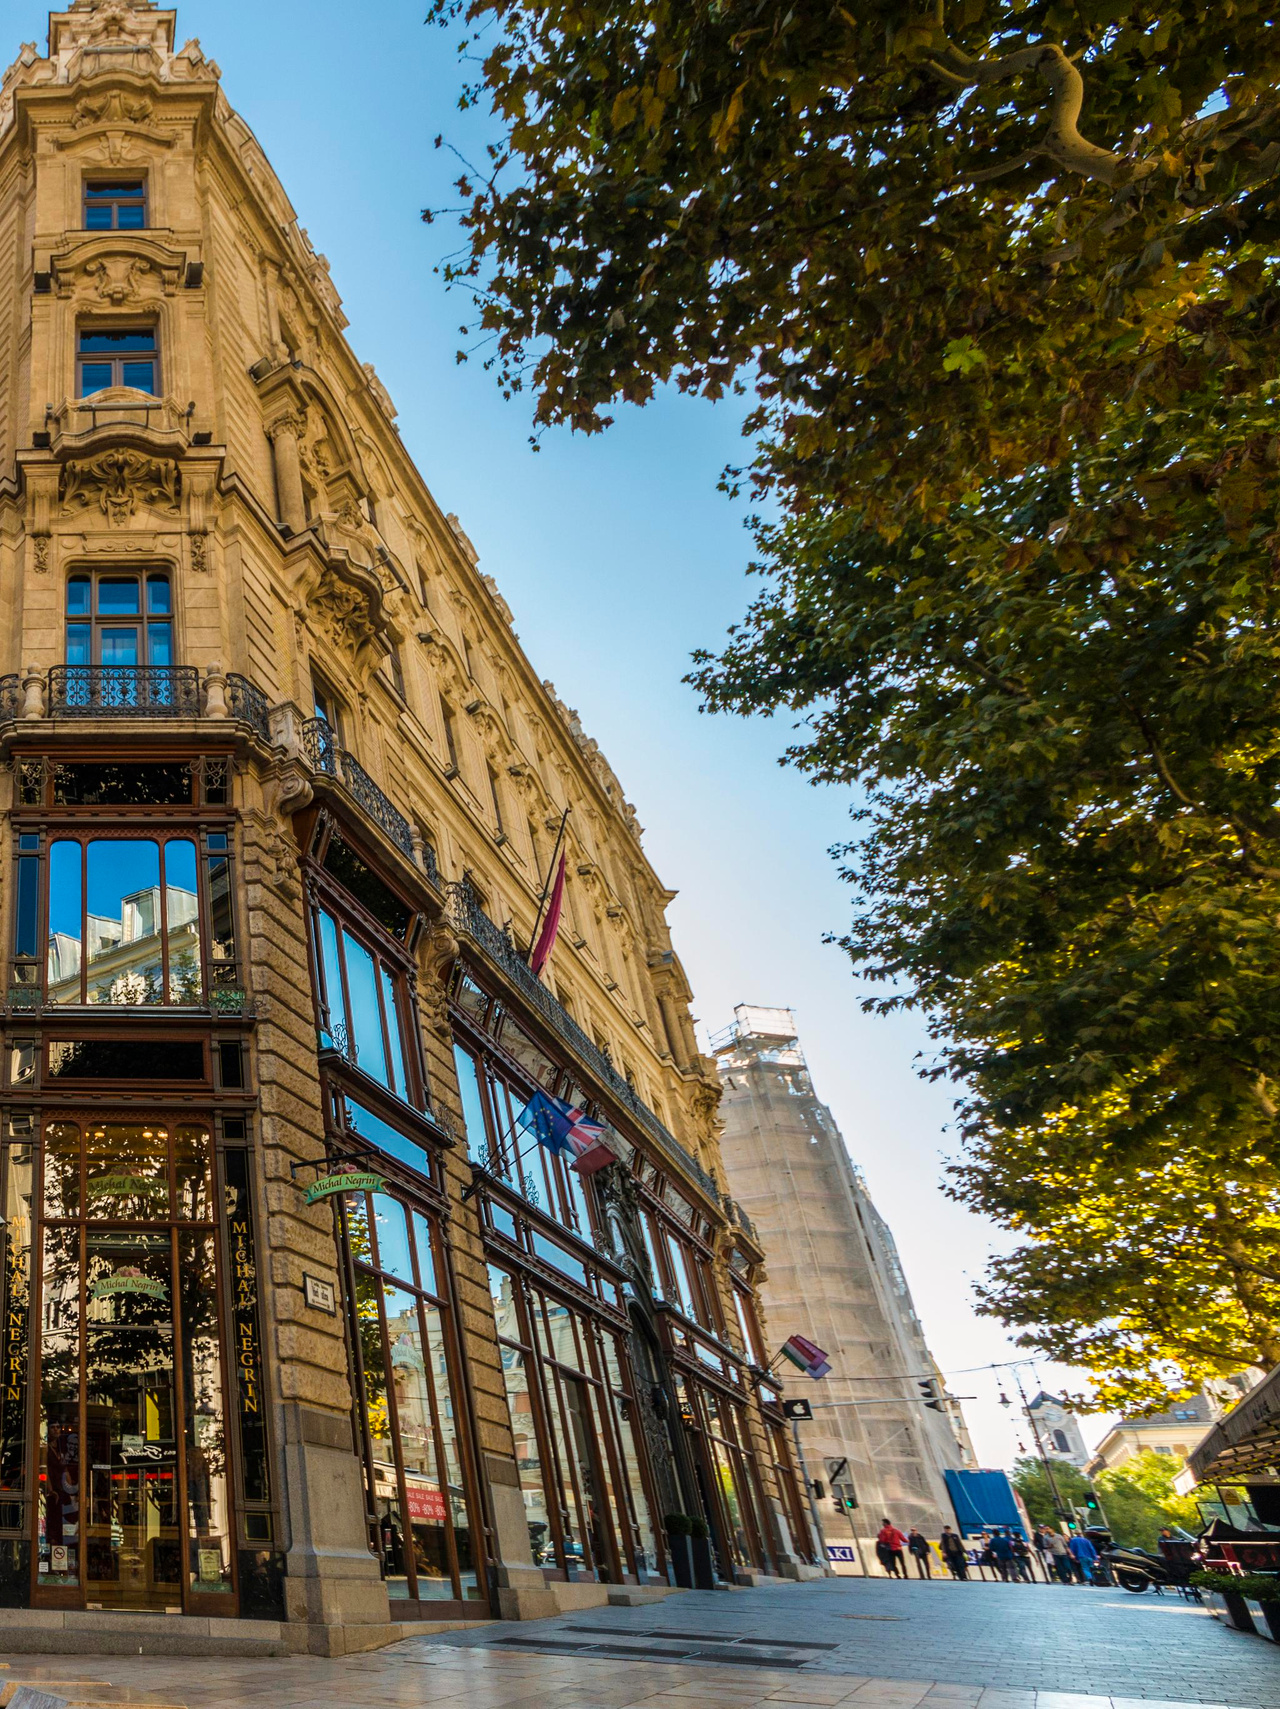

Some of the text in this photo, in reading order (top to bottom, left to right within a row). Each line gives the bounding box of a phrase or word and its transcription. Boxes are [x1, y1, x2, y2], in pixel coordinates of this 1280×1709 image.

[313, 1175, 375, 1193] Michal Negrin
[7, 1216, 26, 1400] MICHAL NEGRIN
[101, 1278, 159, 1291] Michal Negrin
[232, 1222, 258, 1412] MICHAL NEGRIN
